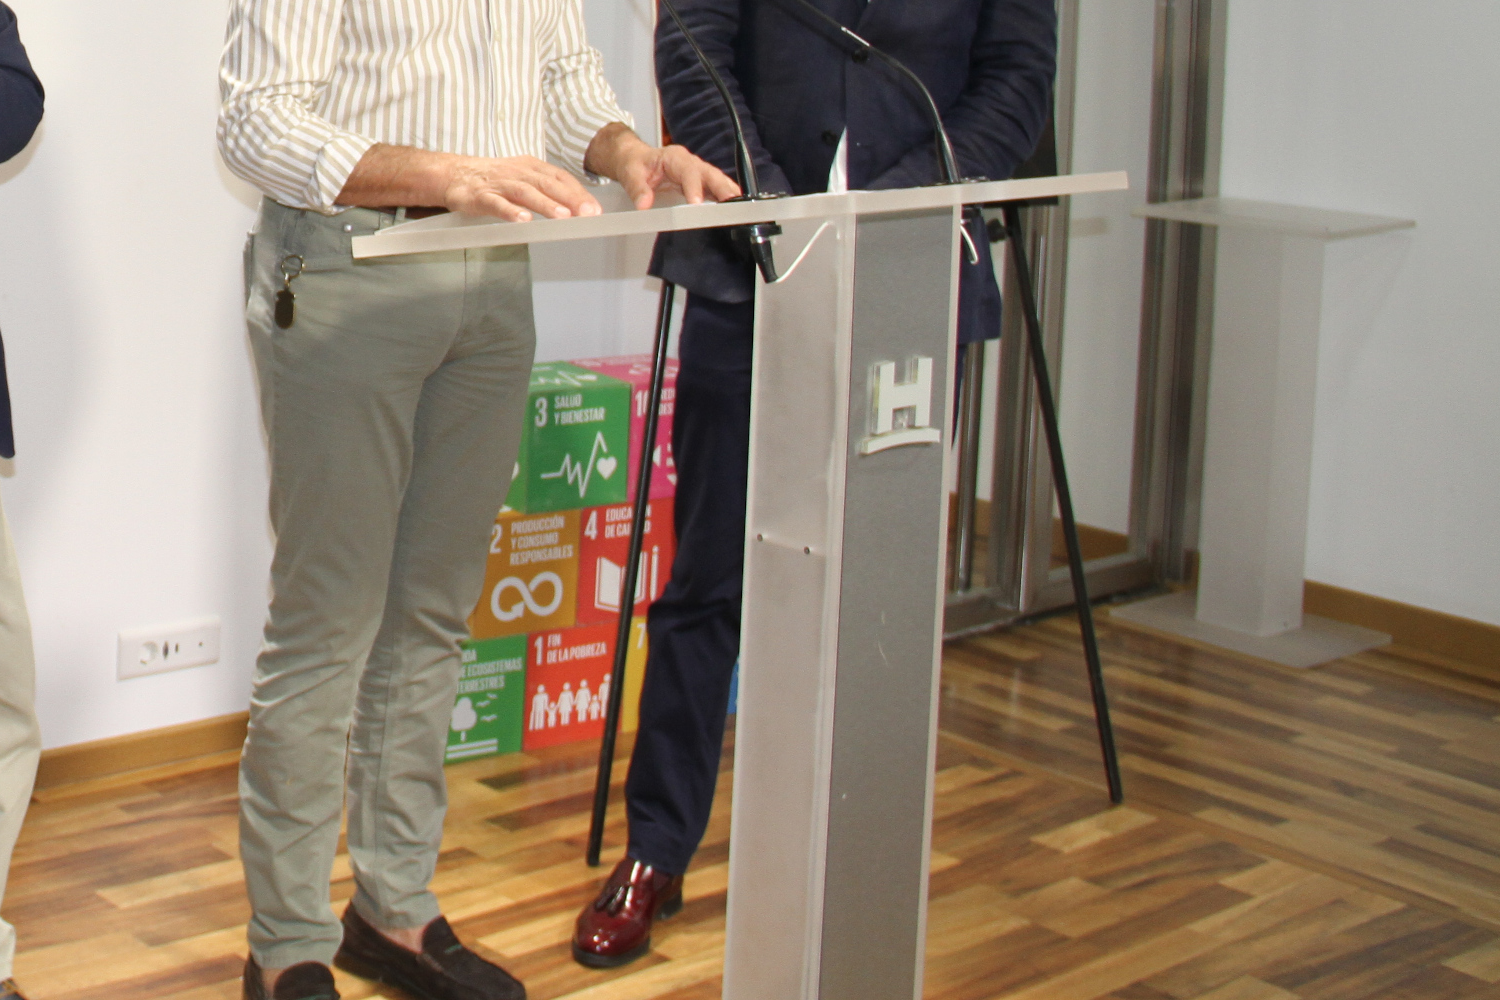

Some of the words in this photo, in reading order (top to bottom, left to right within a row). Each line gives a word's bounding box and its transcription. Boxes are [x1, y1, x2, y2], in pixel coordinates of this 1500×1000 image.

[554, 394, 582, 409] SALUD
[535, 397, 548, 427] 3
[554, 412, 560, 425] Y
[561, 407, 605, 424] BIENESTAR
[511, 515, 565, 534] PRODUCCIÓN
[584, 510, 597, 540] 4
[605, 525, 616, 539] DE
[489, 524, 503, 553] 2
[511, 537, 516, 549] Y
[517, 532, 559, 548] CONSUMO
[510, 545, 573, 566] RESPONSABLES
[547, 634, 561, 647] FIN
[534, 636, 543, 666] 1
[547, 650, 558, 663] DE
[559, 649, 568, 662] LA
[569, 642, 607, 659] POBREZA
